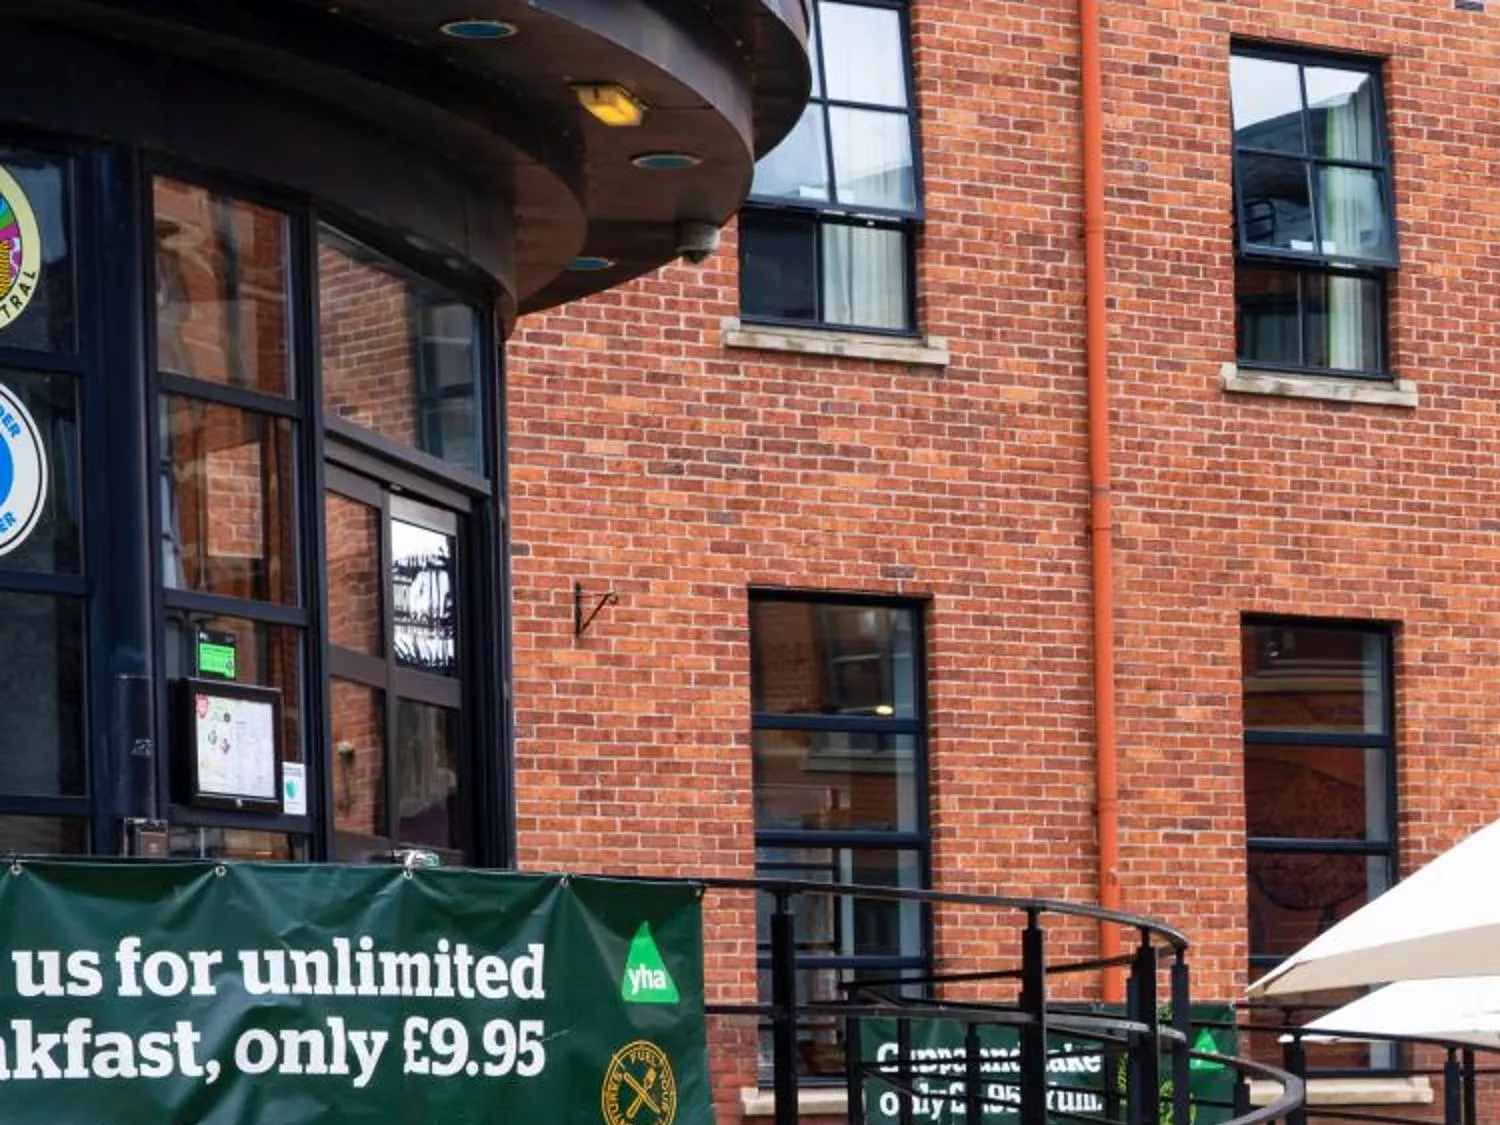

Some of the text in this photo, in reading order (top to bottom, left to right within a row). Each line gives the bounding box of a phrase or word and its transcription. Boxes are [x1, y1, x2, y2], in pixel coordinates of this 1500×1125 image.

[11, 936, 546, 999] us for unlimited
[626, 963, 668, 996] yha
[0, 1015, 546, 1088] kfast, only £9.95
